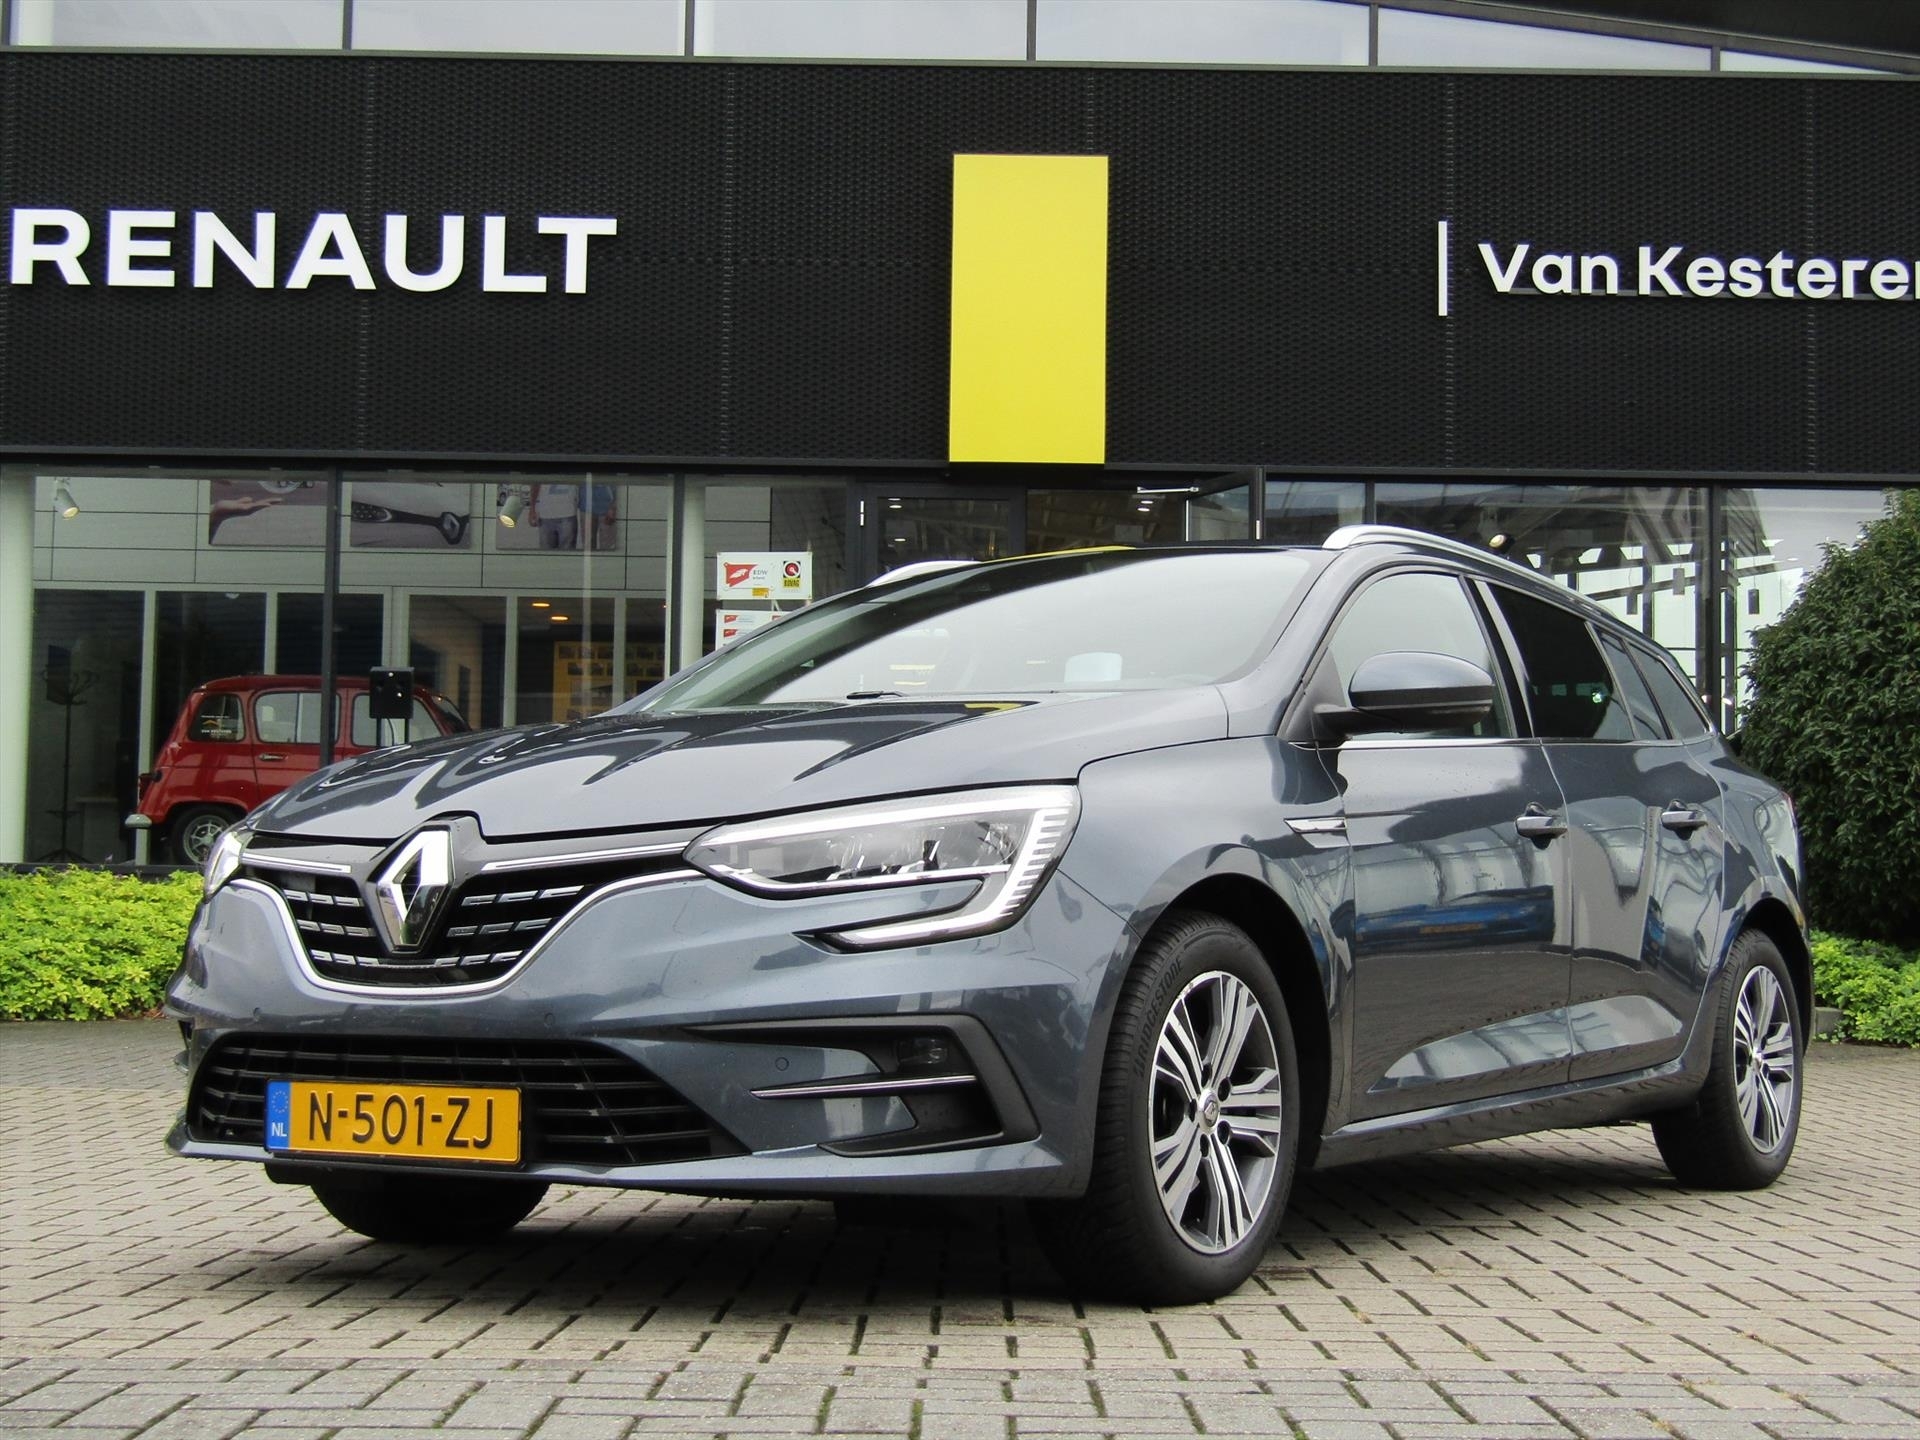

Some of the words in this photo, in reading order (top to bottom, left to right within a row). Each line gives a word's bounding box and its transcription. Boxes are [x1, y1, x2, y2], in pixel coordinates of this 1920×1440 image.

[11, 208, 617, 294] RENAULT
[1478, 243, 1619, 294] Van
[271, 1122, 287, 1137] NL
[309, 1091, 494, 1149] N-501-ZJ
